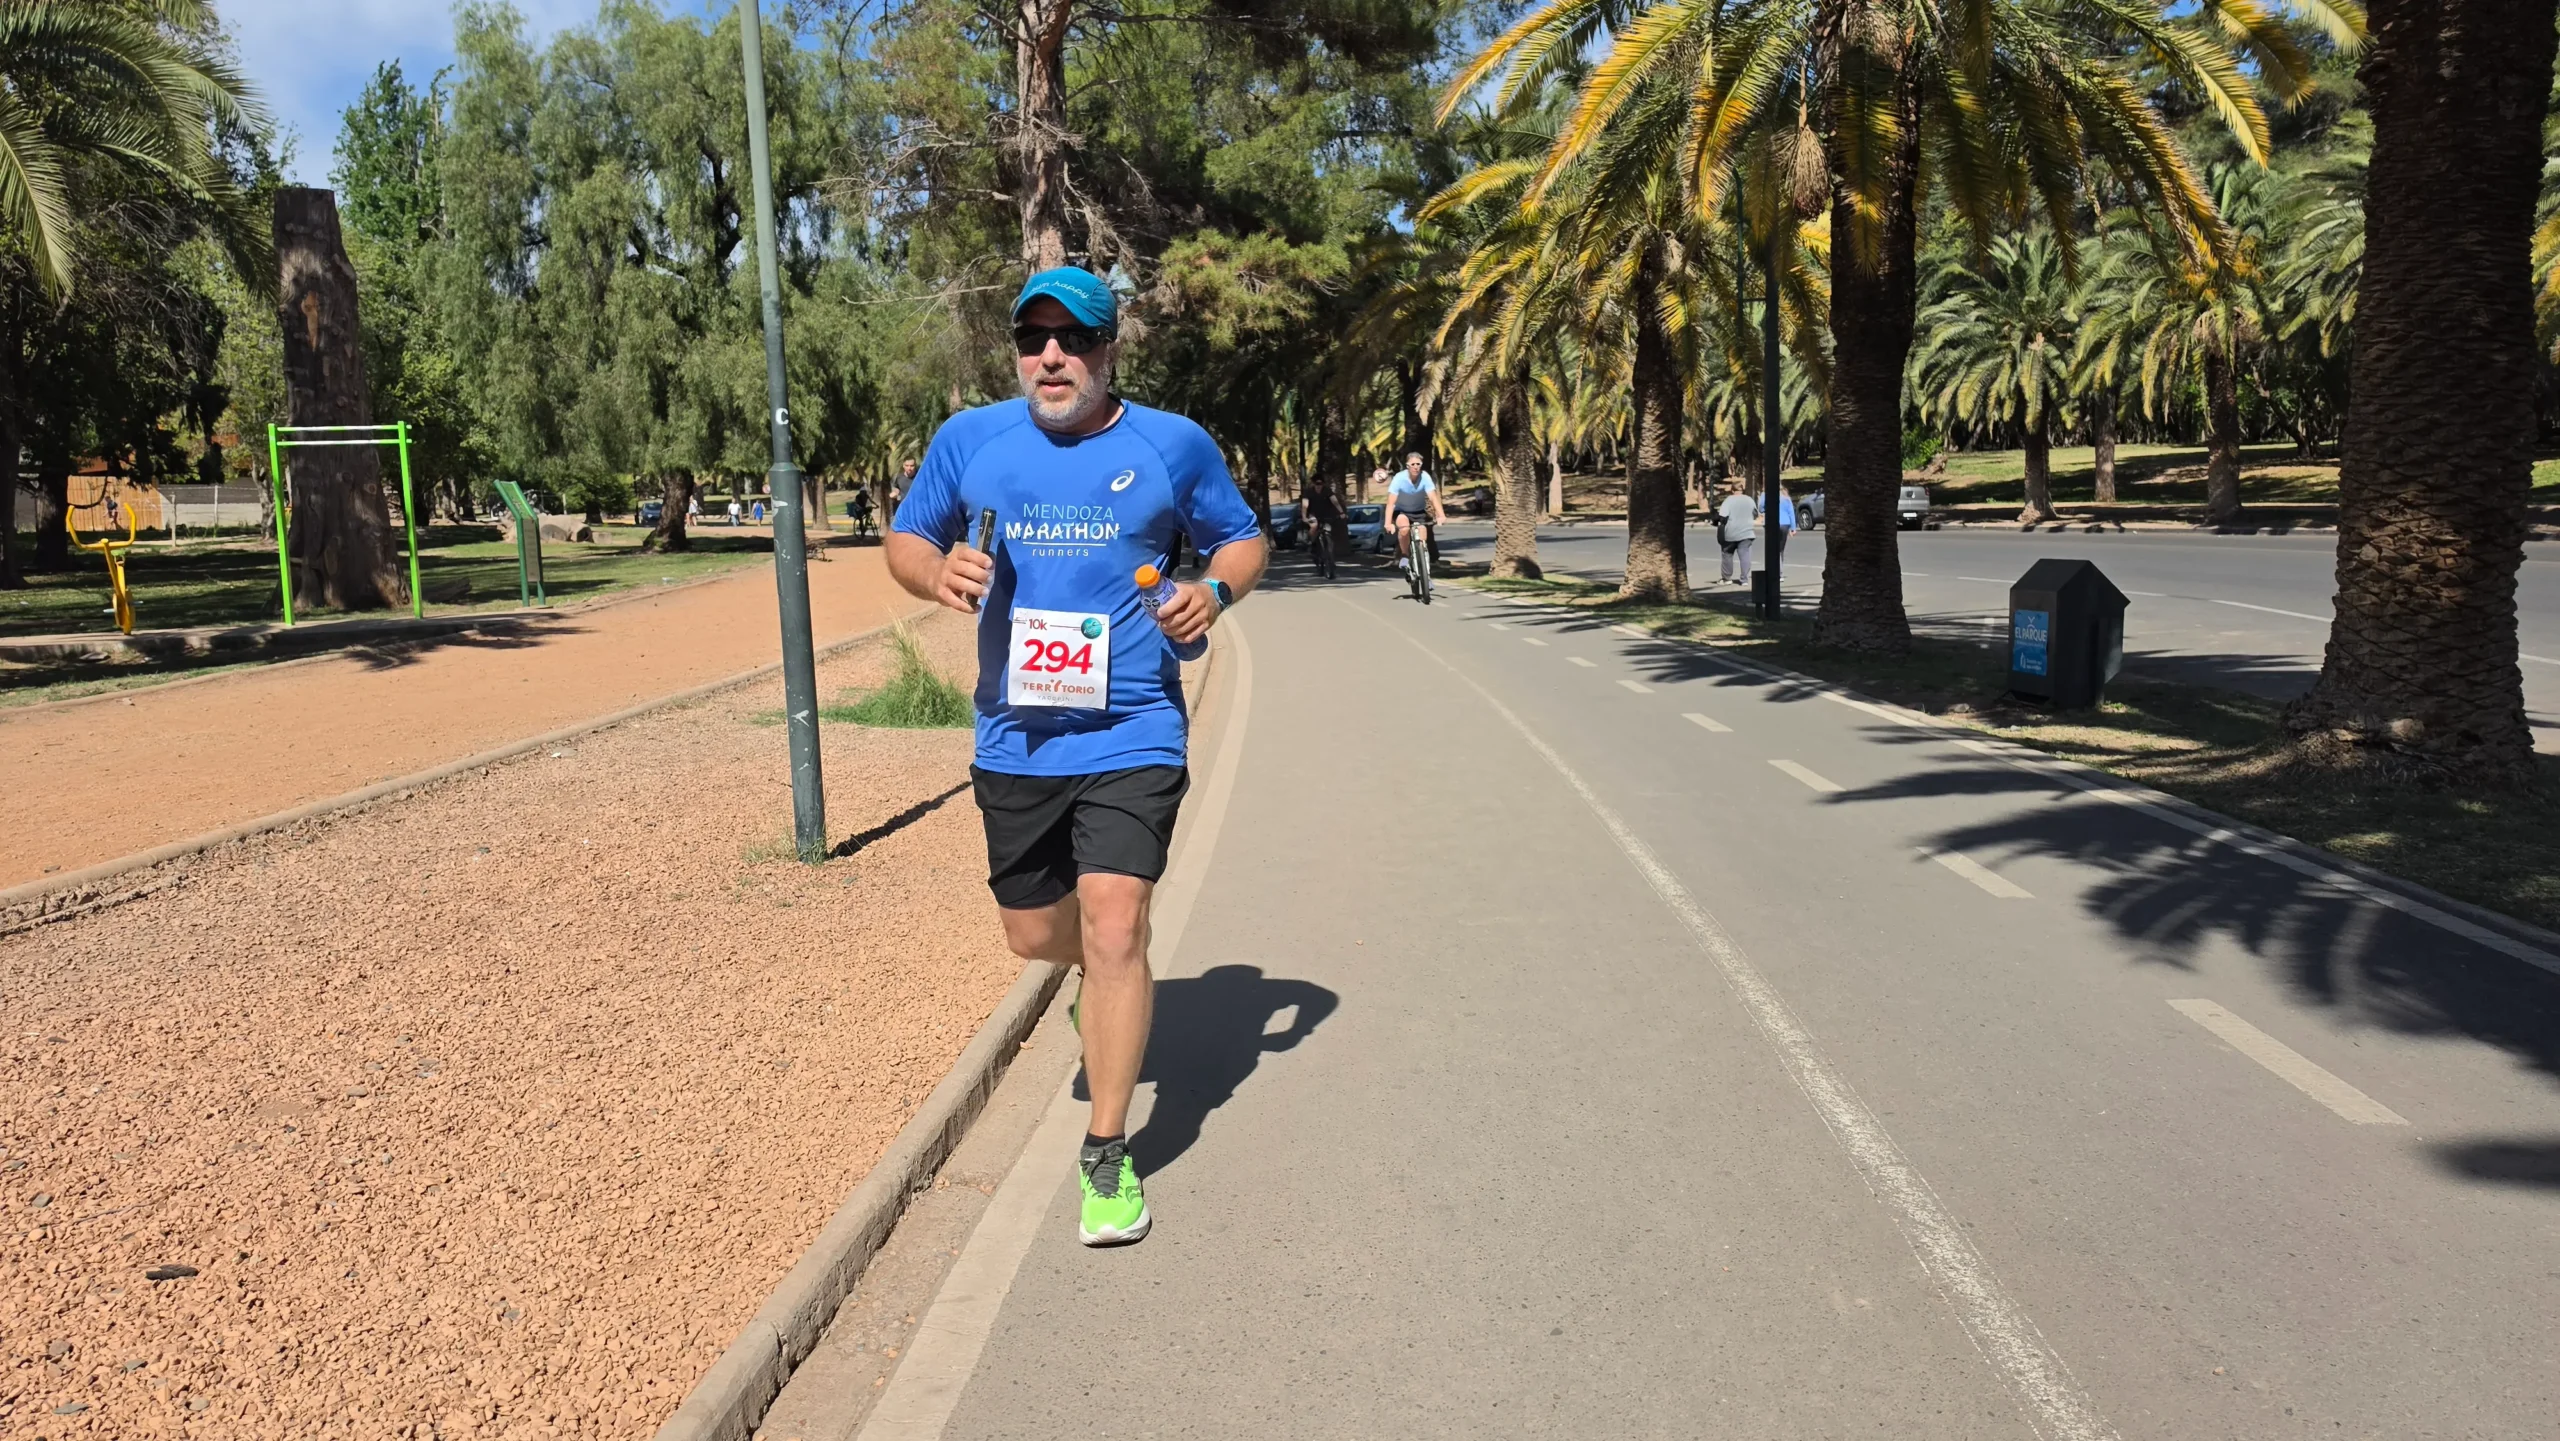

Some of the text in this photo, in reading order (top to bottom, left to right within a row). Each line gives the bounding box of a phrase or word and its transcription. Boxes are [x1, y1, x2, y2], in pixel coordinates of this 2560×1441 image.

[1051, 280, 1090, 299] happy
[1023, 503, 1115, 521] MENDOZA
[1005, 520, 1120, 540] MARATHON
[1032, 548, 1089, 557] runners
[1028, 618, 1048, 631] 10k
[2015, 627, 2047, 642] EL PARQUE
[1019, 639, 1094, 674] 294
[1022, 679, 1095, 694] TERRITORIO
